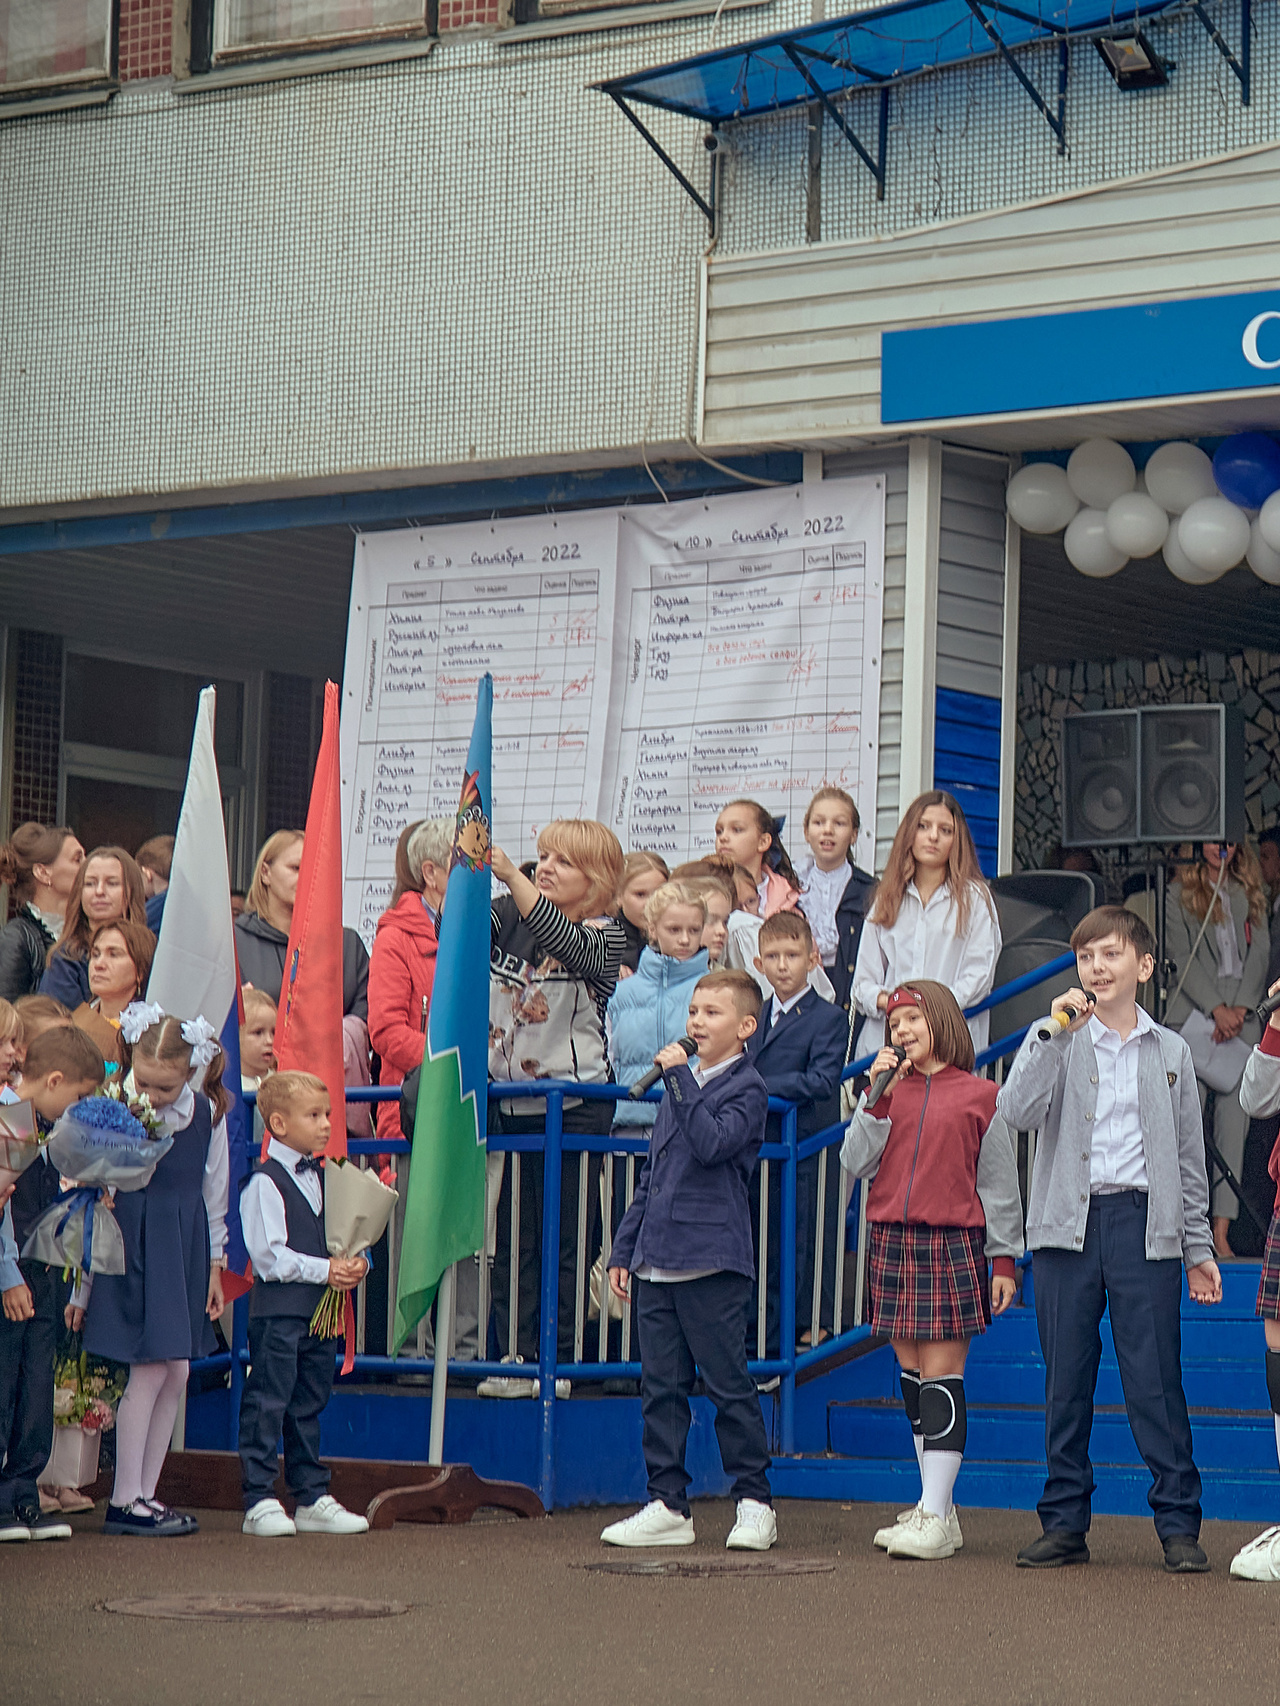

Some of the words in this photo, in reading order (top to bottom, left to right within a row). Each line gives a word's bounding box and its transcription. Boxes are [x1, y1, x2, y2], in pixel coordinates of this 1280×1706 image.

[804, 515, 845, 536] 2022
[541, 543, 581, 562] 2022
[530, 825, 538, 840] 5
